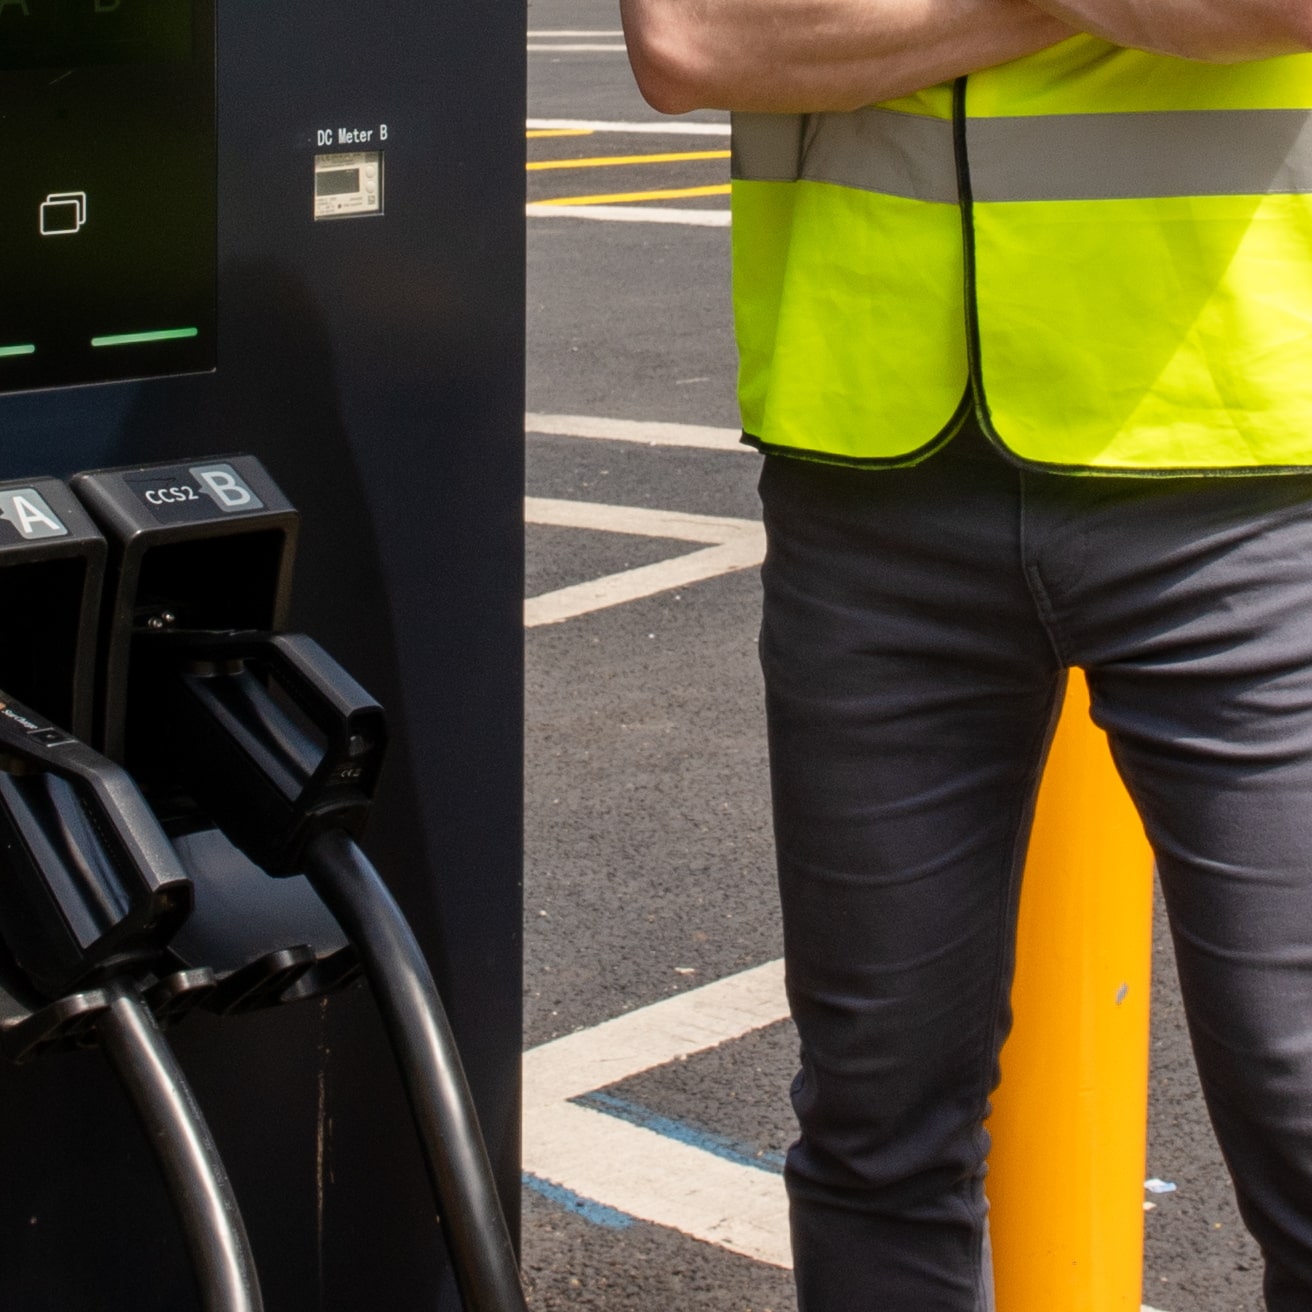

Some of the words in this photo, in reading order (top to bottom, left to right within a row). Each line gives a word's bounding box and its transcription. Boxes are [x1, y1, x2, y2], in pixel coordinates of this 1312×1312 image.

[317, 129, 333, 146] DC
[338, 127, 373, 144] Meter
[379, 124, 388, 141] B
[143, 484, 200, 506] CCS2
[199, 470, 253, 507] B
[12, 494, 61, 534] A
